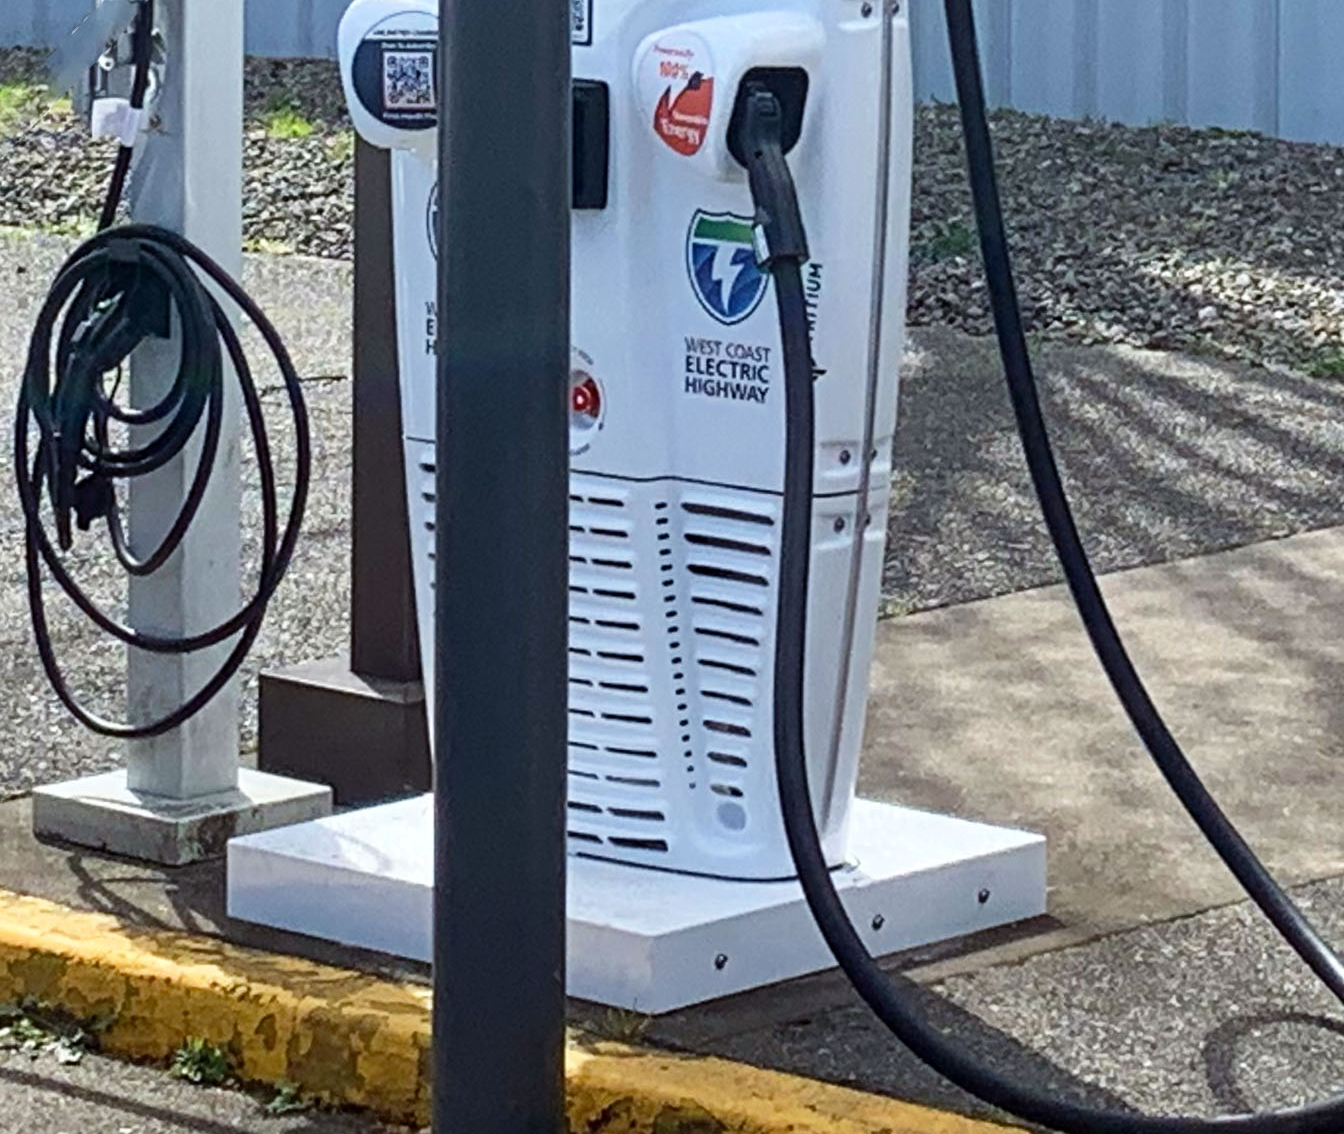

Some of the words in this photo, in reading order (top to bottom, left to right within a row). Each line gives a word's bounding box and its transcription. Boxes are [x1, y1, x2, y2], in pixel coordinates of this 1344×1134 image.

[684, 336, 722, 356] WEST
[725, 342, 772, 363] COAST
[685, 355, 770, 384] ELECTRIC
[684, 376, 770, 404] HIGHWAY
